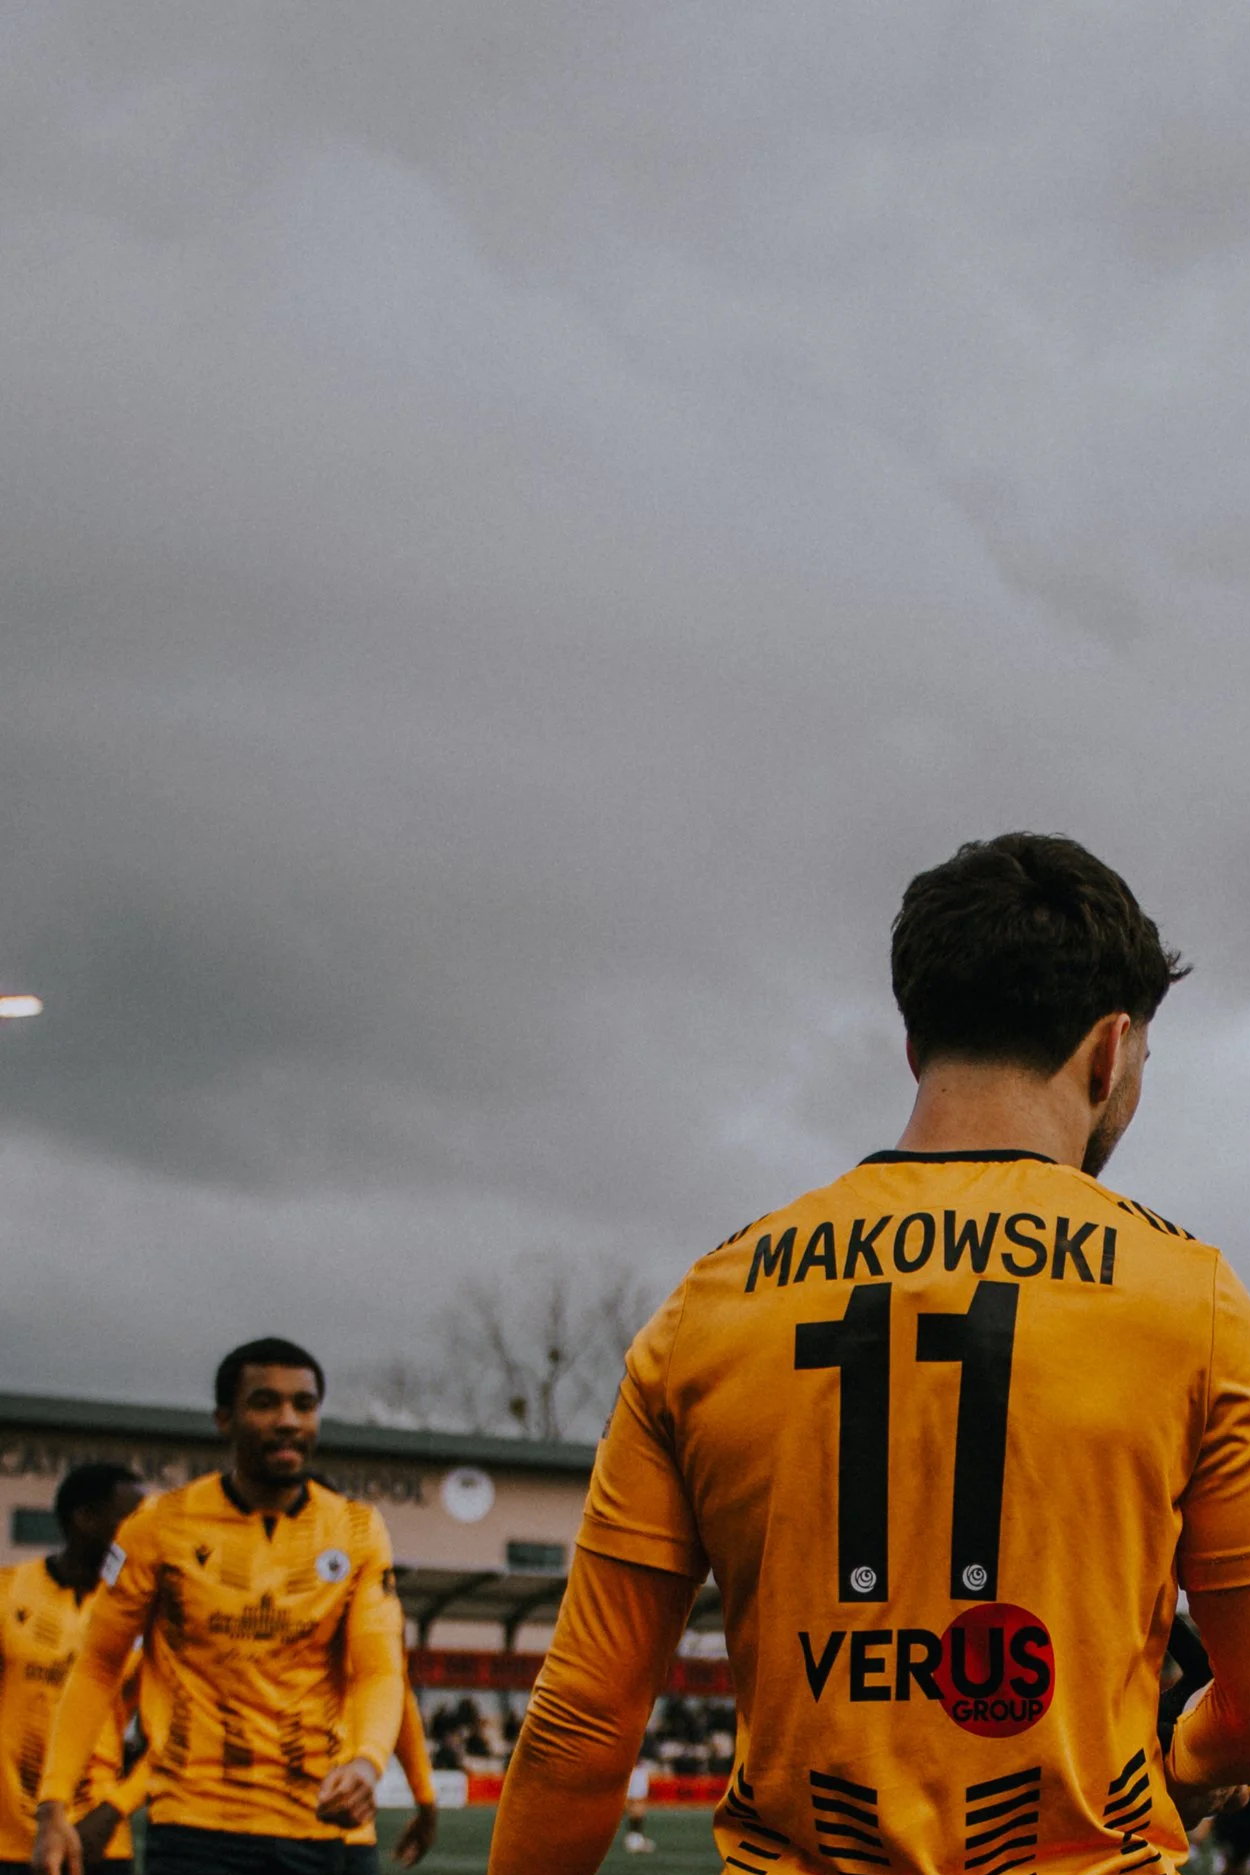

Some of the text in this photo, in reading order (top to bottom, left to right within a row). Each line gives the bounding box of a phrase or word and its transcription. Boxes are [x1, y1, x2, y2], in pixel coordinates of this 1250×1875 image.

[743, 1209, 1117, 1293] MAKOWSKI
[795, 1281, 1019, 1603] 11
[798, 1625, 1052, 1704] VERUS
[952, 1700, 1045, 1723] GROUP
